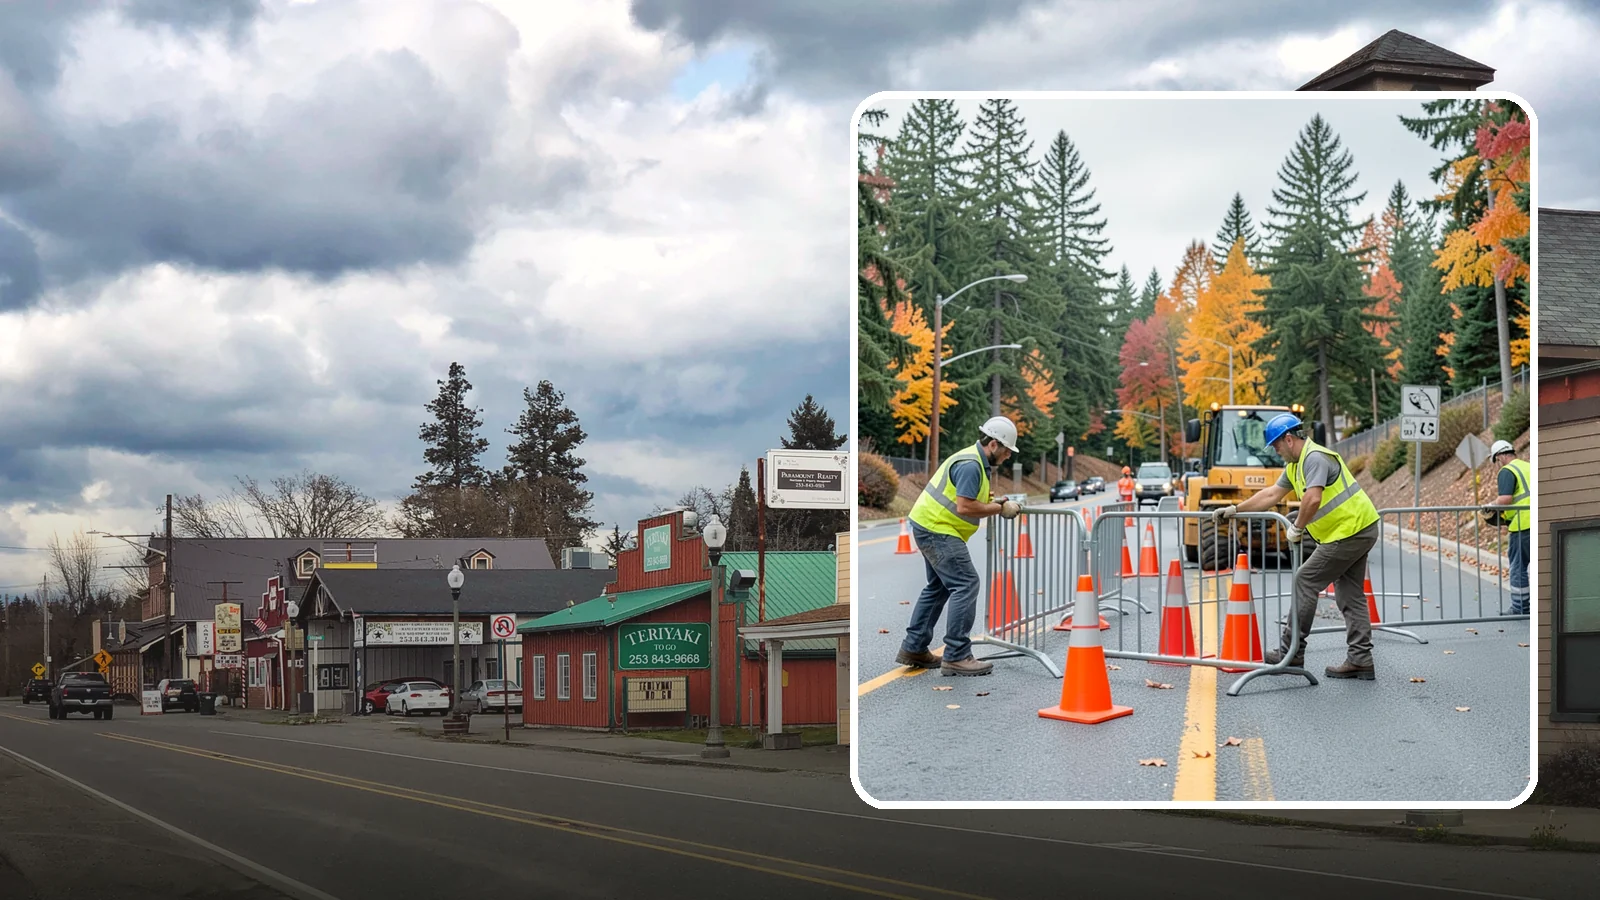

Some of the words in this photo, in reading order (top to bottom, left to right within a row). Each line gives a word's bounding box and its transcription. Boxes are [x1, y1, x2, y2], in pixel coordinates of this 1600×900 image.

[625, 627, 702, 646] TERIYAKI
[628, 654, 649, 665] 253
[651, 653, 700, 665] 843-9668
